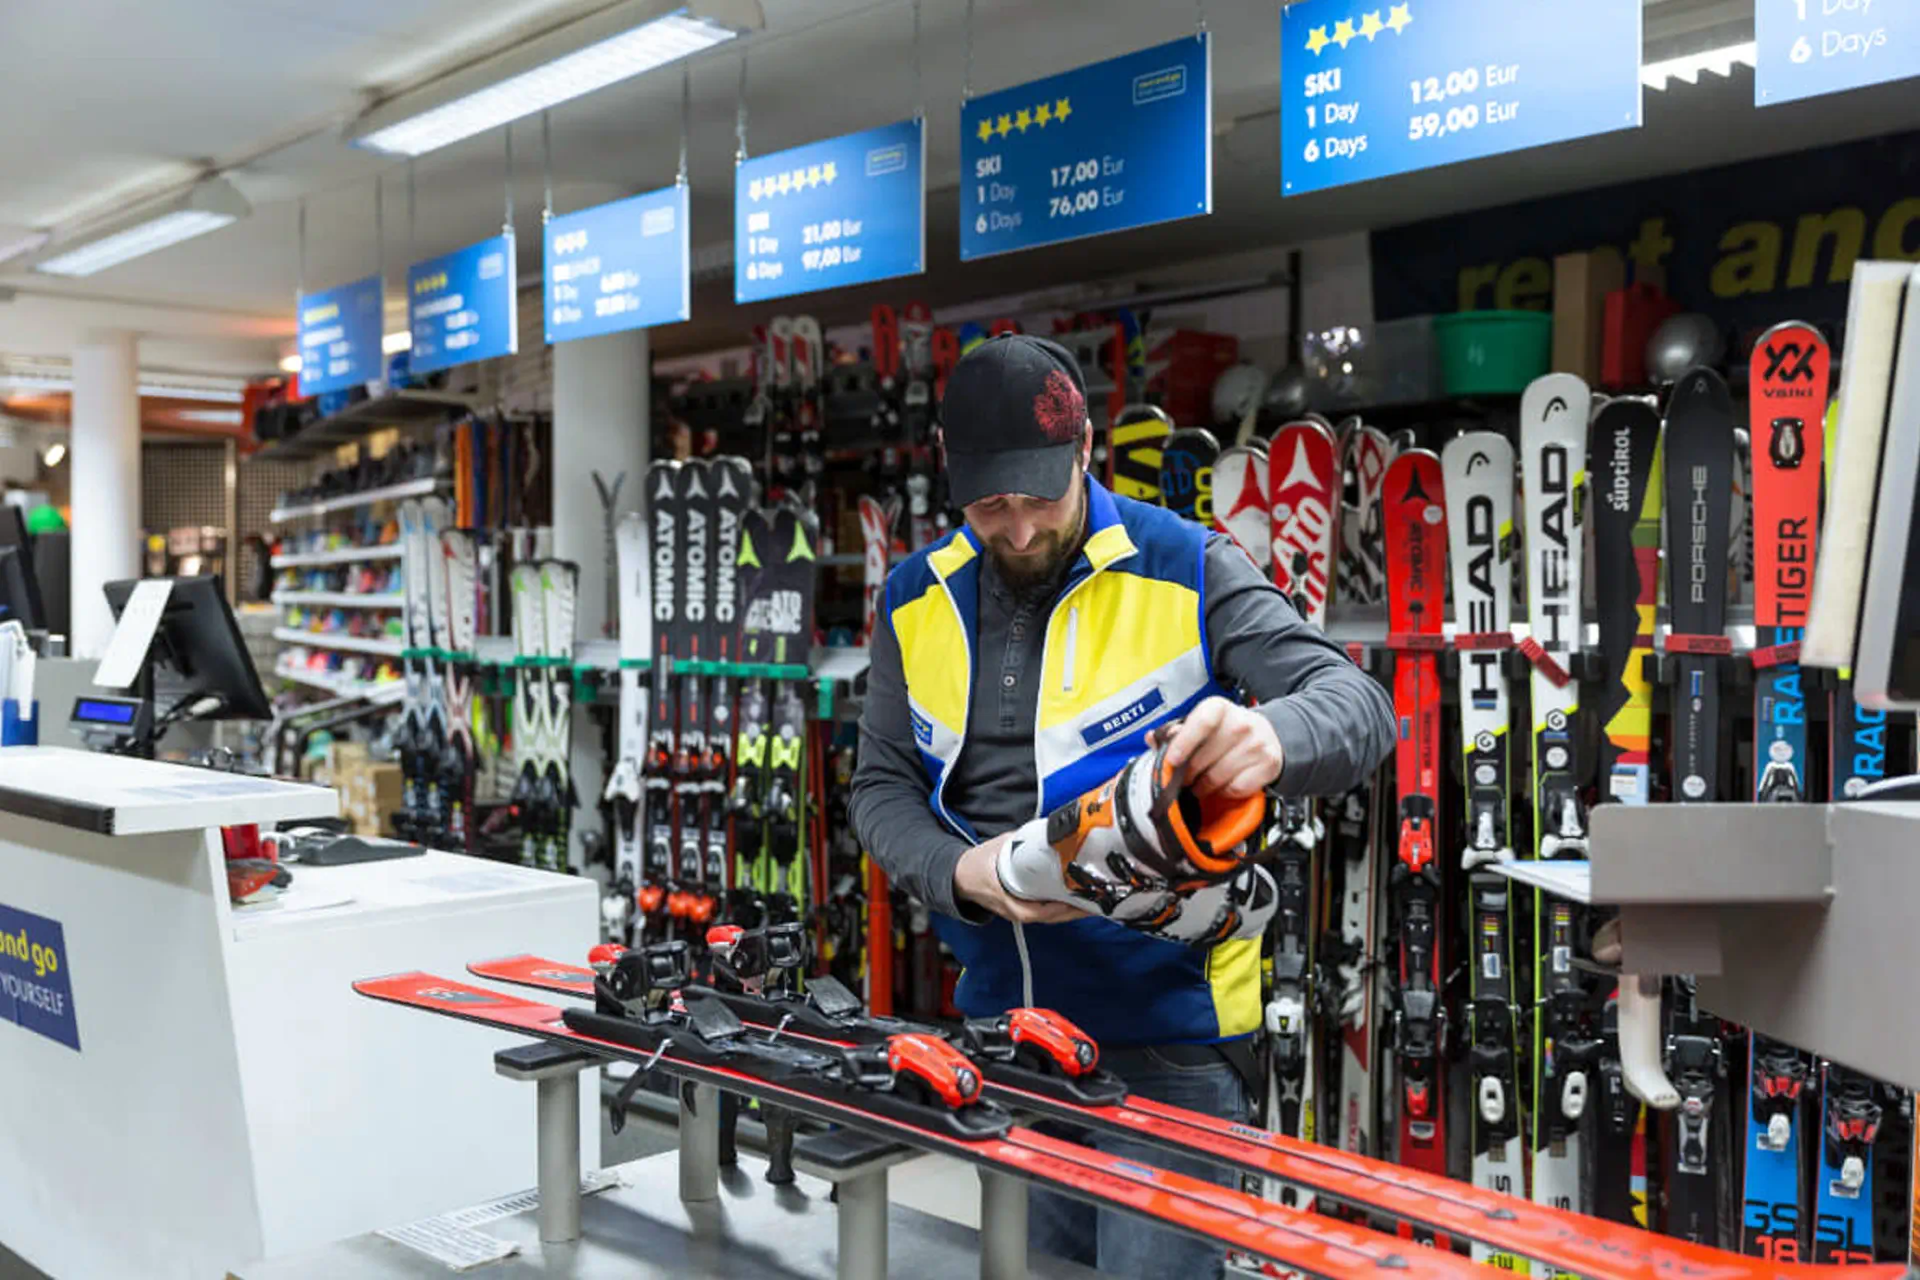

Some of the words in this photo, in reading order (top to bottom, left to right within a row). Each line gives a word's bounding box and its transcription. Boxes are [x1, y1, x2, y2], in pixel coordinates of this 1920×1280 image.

[1795, 0, 1806, 20] 1
[1789, 36, 1812, 64] 6
[1822, 28, 1887, 58] Days
[1304, 68, 1341, 97] SKI
[1410, 68, 1478, 104] 12,00
[1485, 64, 1520, 87] Eur
[1305, 105, 1316, 129] 1
[1324, 102, 1359, 124] Day
[1408, 104, 1479, 140] 59,00
[1485, 101, 1520, 124] Eur
[1303, 139, 1320, 162] 6
[1325, 135, 1368, 159] Days
[975, 155, 1001, 178] SKI
[1050, 158, 1099, 188] 17,00
[1103, 155, 1125, 177] Eur
[977, 185, 986, 204] 1
[990, 182, 1017, 203] Day
[1049, 189, 1099, 218] 76,00
[1103, 187, 1125, 207] Eur
[975, 211, 988, 234] 6
[990, 211, 1023, 231] Days
[1458, 218, 1675, 312] ret
[1541, 443, 1569, 652] HEAD
[1691, 465, 1707, 603] PORSCHE
[655, 509, 675, 622] ATOMIC
[685, 508, 706, 622] ATOMIC
[715, 508, 737, 622] ATOMIC
[1466, 495, 1498, 700] HEAD
[1102, 702, 1145, 733] BERTI
[31, 942, 58, 977] go
[0, 972, 64, 1016] YOURSELF
